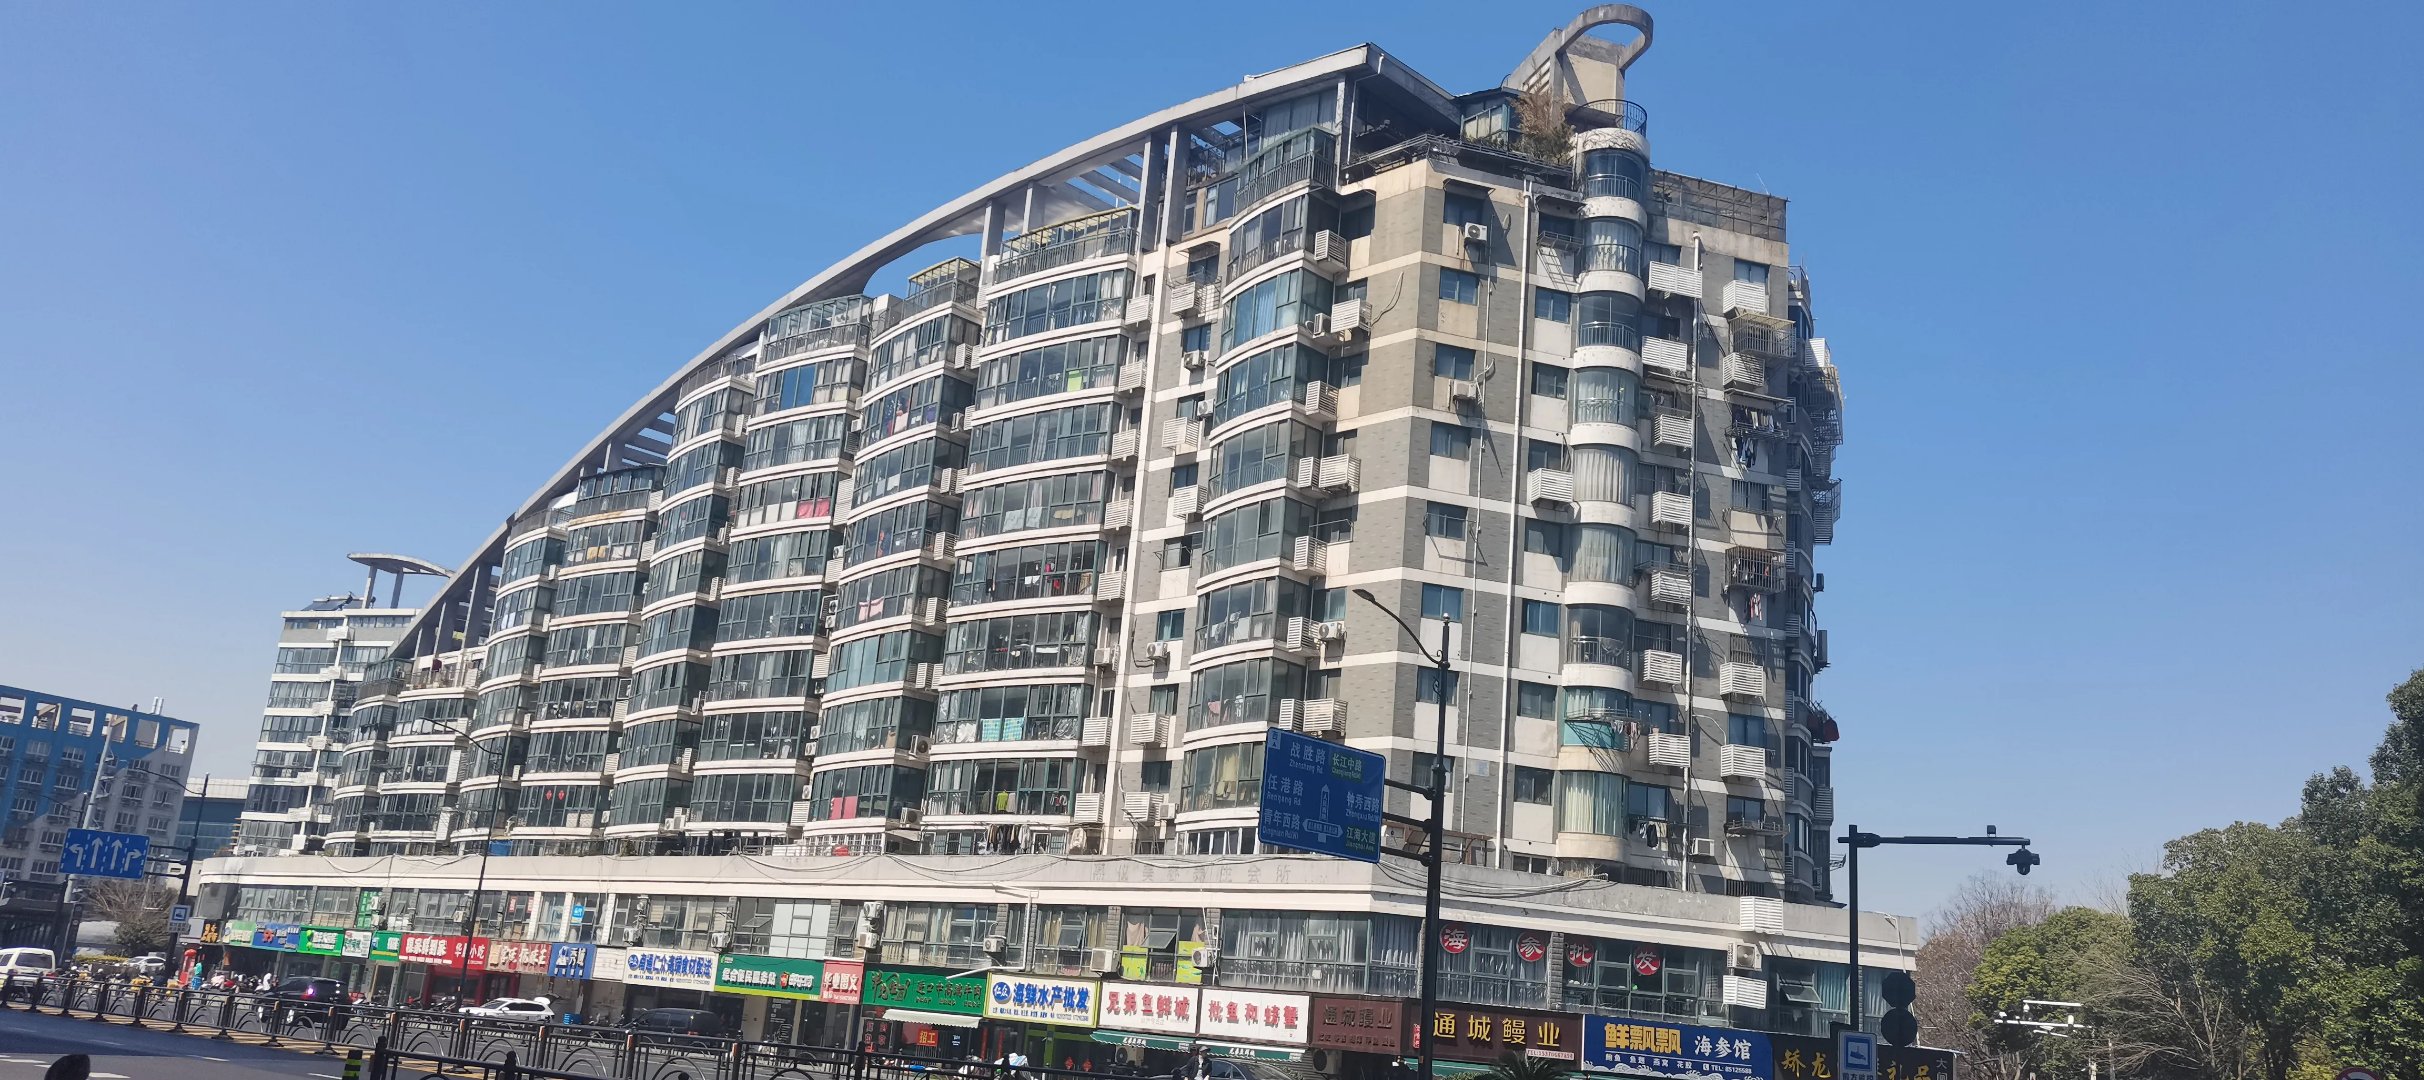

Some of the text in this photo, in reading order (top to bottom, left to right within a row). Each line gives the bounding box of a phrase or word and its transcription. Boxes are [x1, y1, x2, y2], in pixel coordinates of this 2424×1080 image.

[1290, 742, 1325, 765] 战胜路
[1332, 753, 1362, 772] 长江中路
[1267, 774, 1303, 797] 任港路
[1346, 792, 1380, 814] 钟秀西路
[1264, 809, 1300, 830] 青年西路
[1346, 827, 1376, 845] 江海大道
[1013, 982, 1089, 1012] 海鲜水产批发
[1107, 991, 1190, 1019] 兄弟鱼鲜城
[1323, 1004, 1393, 1029] 通城鳗业
[919, 1030, 936, 1043] 招工
[1433, 1012, 1561, 1046] 通城鳗业
[1605, 1023, 1752, 1060] 鲜飘飘 海参馆
[1653, 1058, 1669, 1067] 燕窝
[1676, 1060, 1693, 1069] 花胶
